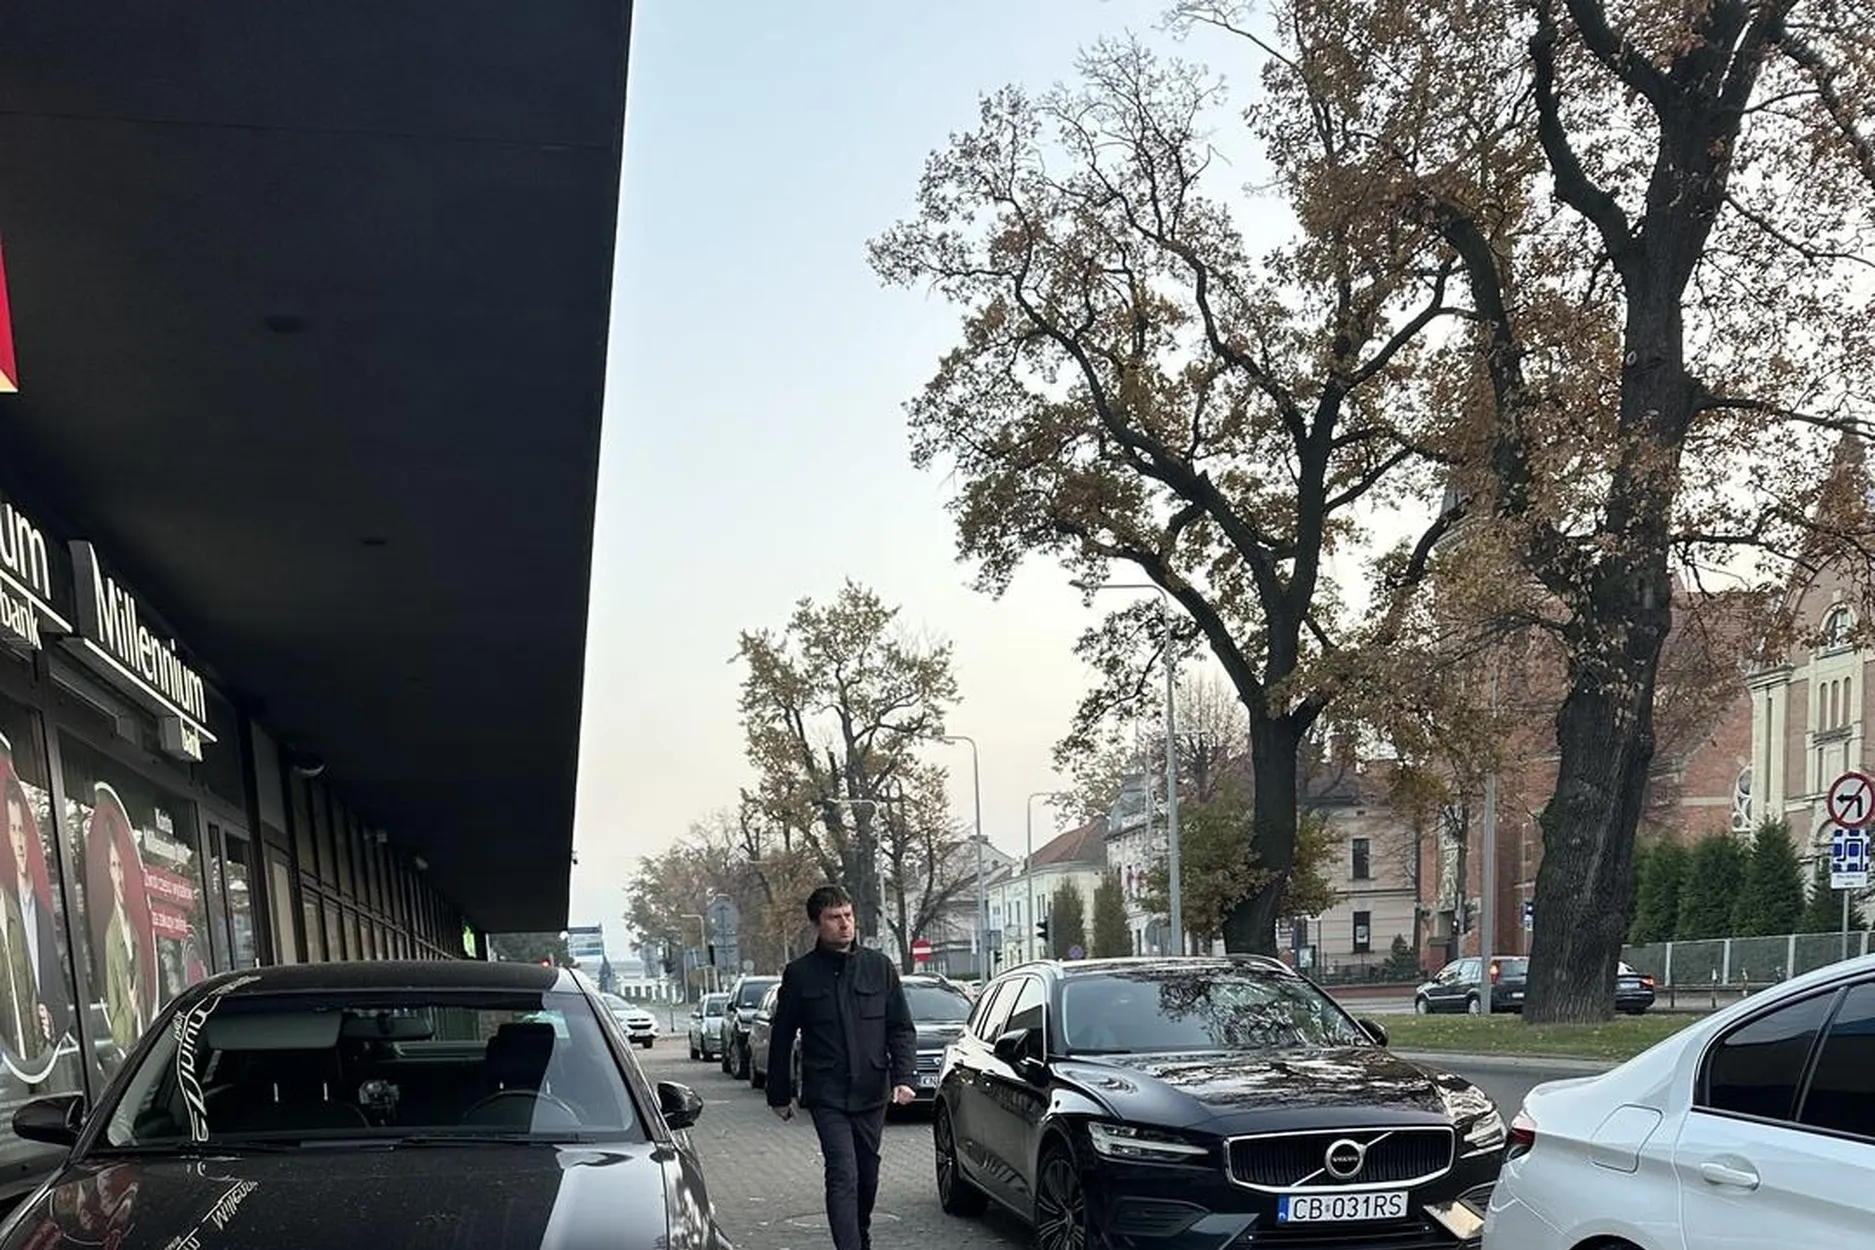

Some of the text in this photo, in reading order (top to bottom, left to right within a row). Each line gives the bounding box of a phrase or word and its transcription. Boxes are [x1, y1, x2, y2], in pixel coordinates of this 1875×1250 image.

[0, 577, 42, 651] bank
[88, 541, 206, 724] Millennium
[180, 717, 203, 762] bank
[1293, 1198, 1323, 1220] CB
[1332, 1194, 1402, 1219] 031RS
